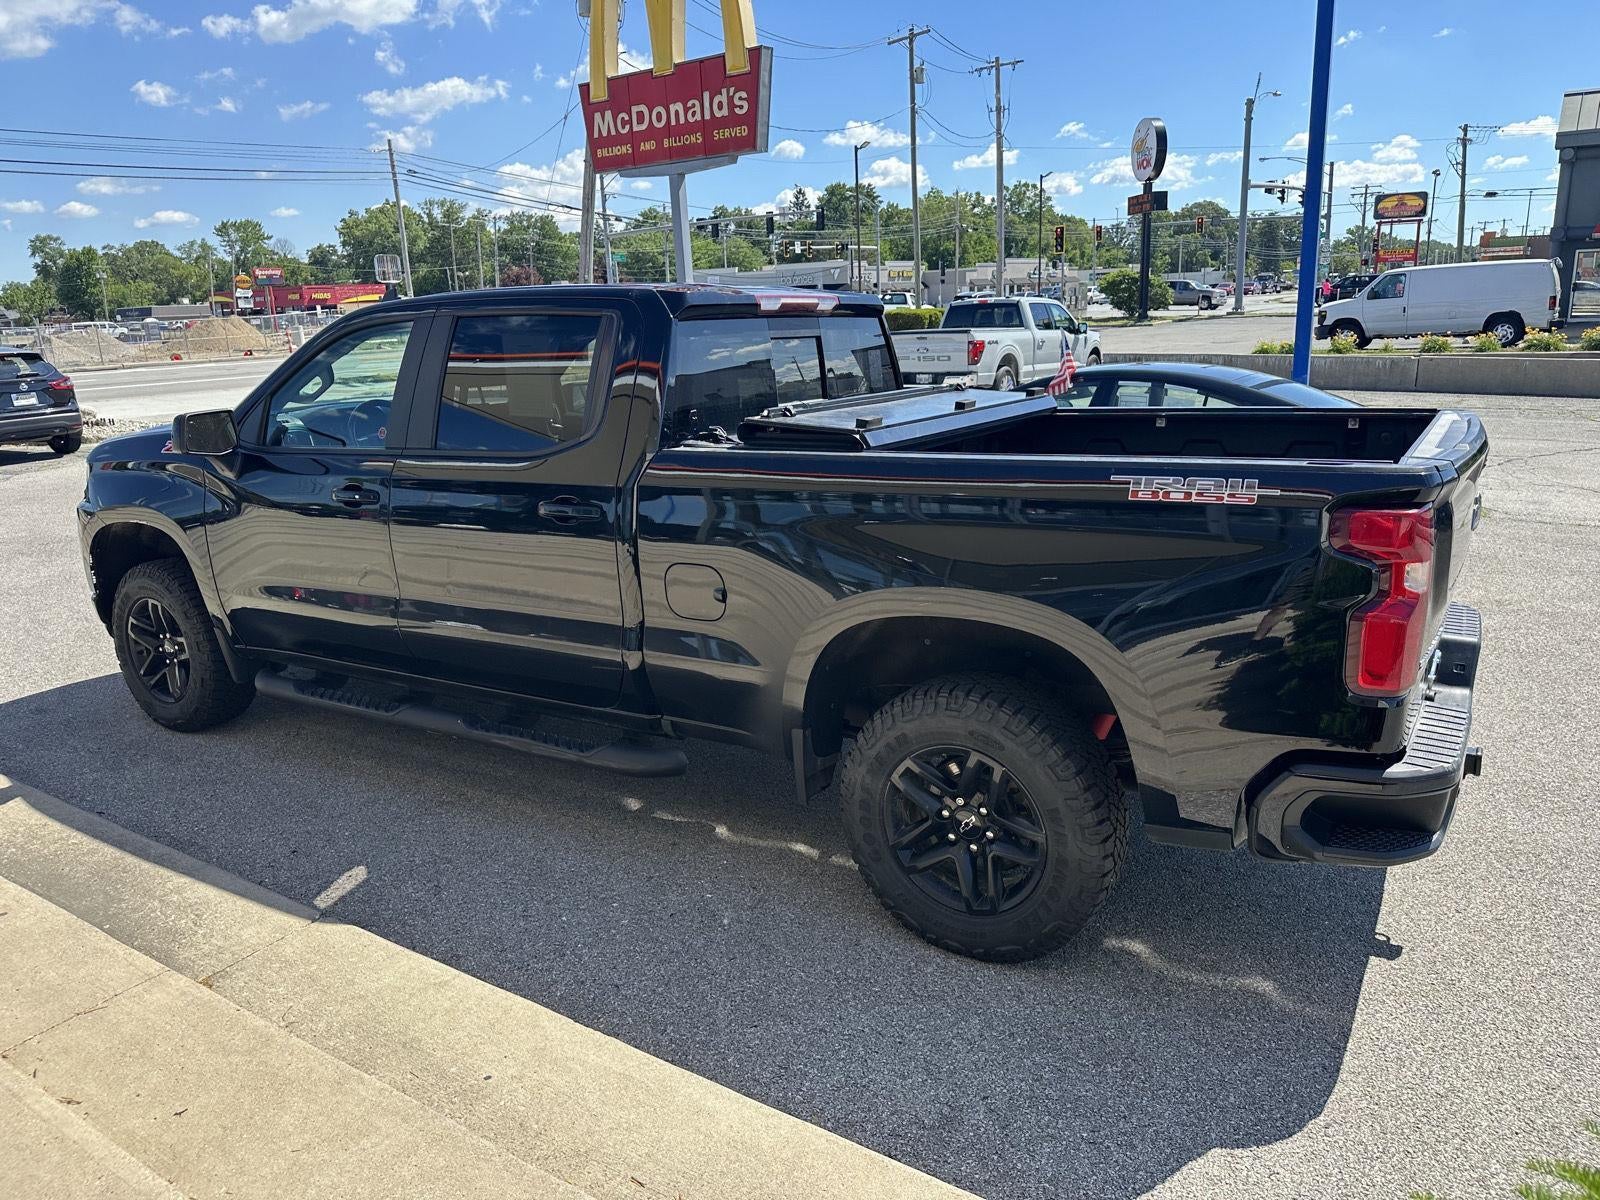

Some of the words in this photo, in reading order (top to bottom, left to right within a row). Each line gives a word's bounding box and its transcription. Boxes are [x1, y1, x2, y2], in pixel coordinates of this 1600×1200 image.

[593, 87, 749, 139] McDonald's
[597, 144, 633, 158] BILLIONS
[640, 141, 656, 152] AND
[663, 133, 703, 148] BILLIONS
[713, 125, 748, 141] SERVED
[1136, 158, 1151, 170] WOK
[311, 292, 331, 300] MIDAS
[1110, 475, 1281, 496] TRAIL
[1128, 489, 1258, 505] BOSS
